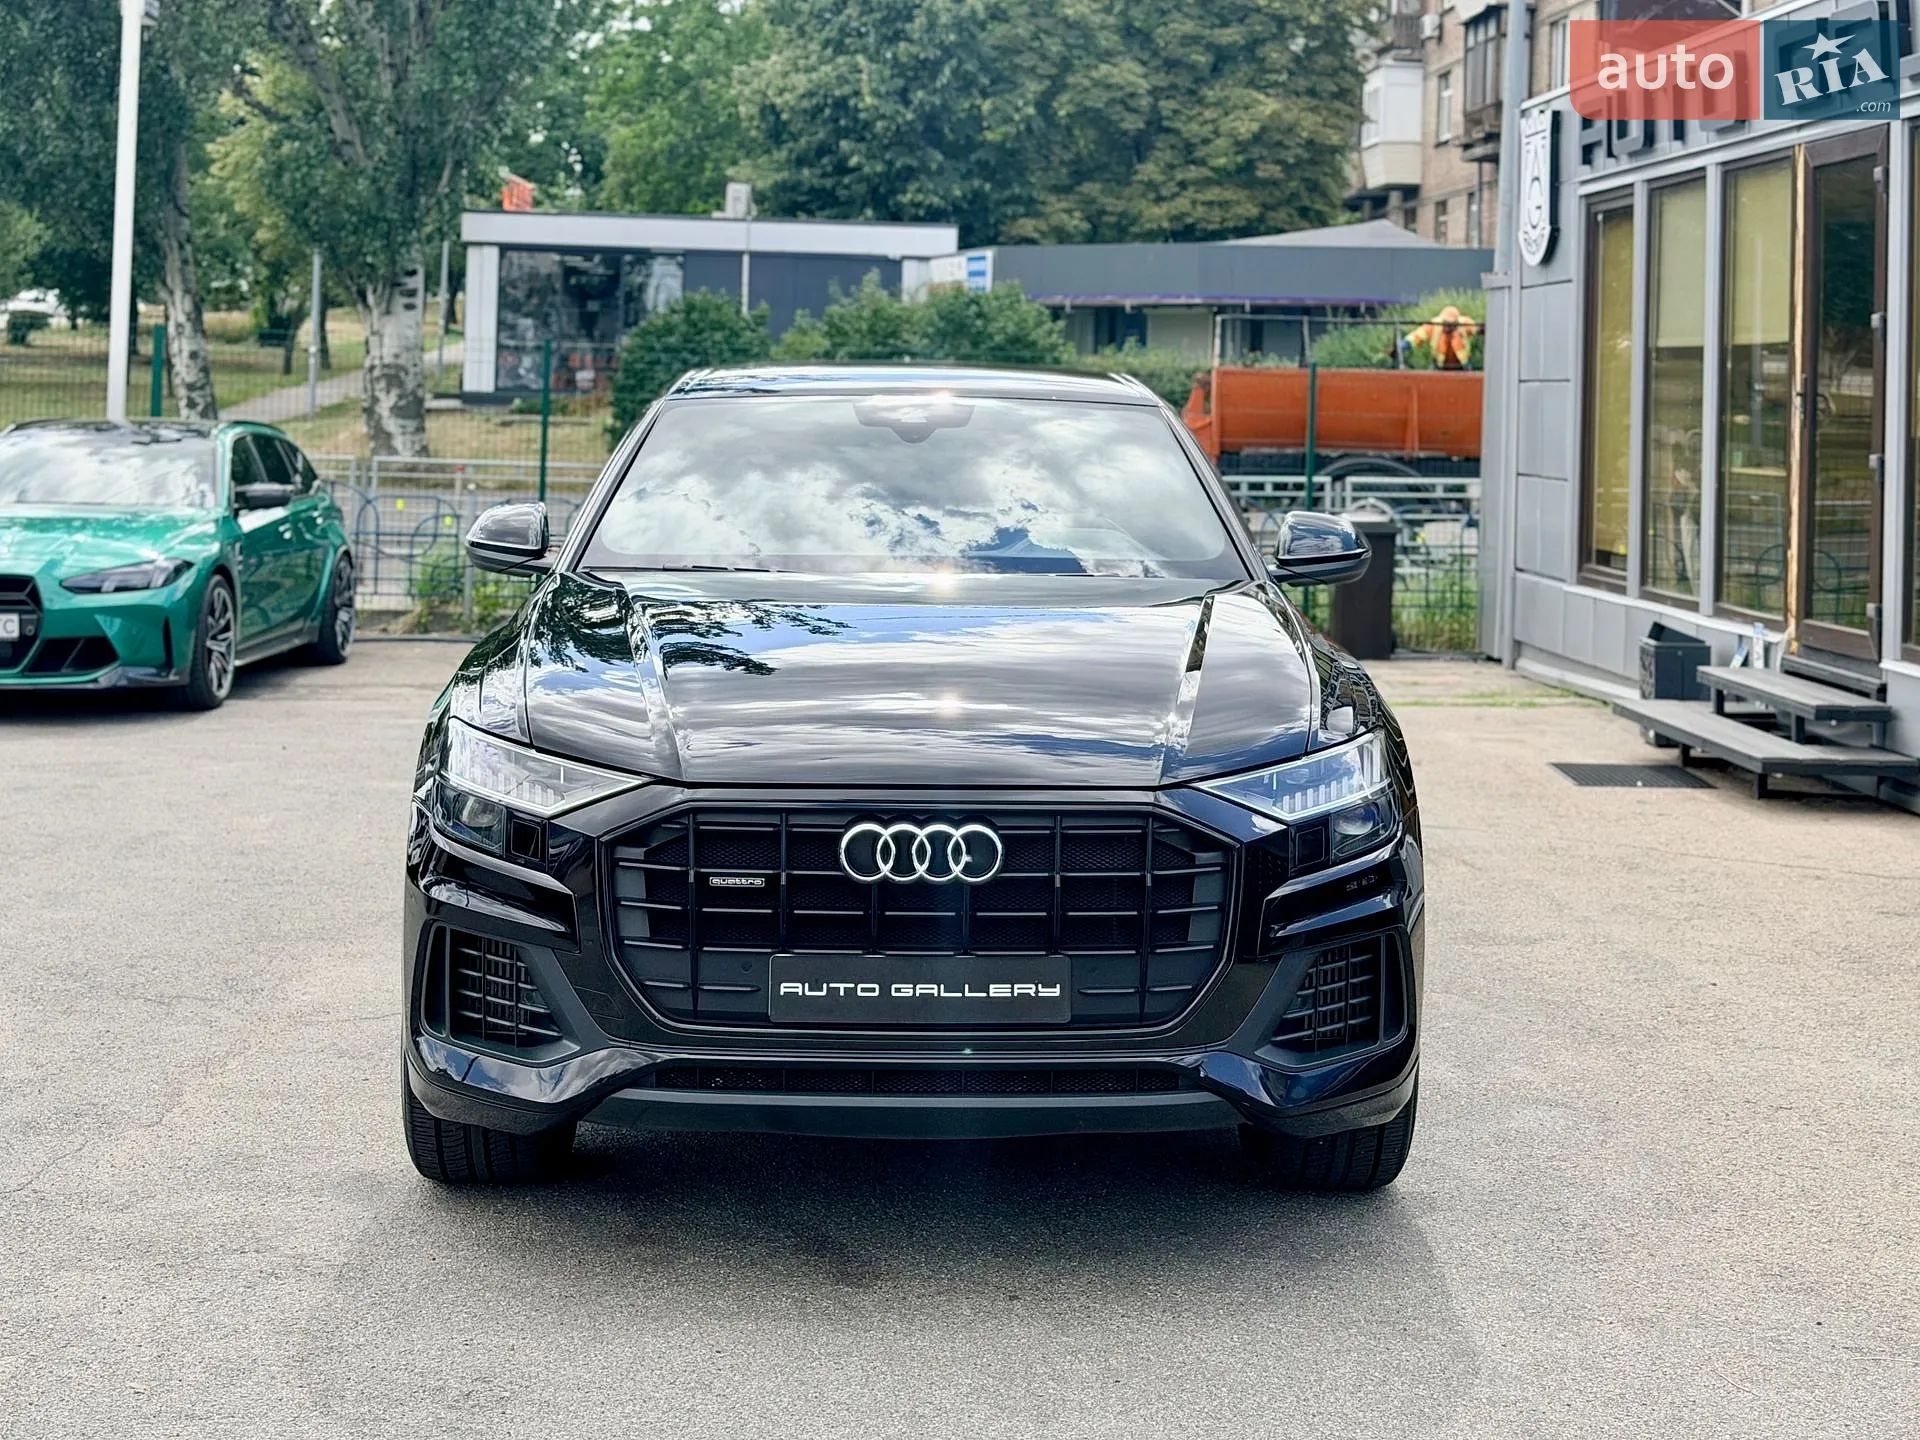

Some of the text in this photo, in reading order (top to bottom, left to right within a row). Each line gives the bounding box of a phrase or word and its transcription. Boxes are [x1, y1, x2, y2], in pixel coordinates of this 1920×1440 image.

[0, 618, 16, 635] C
[712, 877, 762, 886] quattro
[779, 982, 1061, 997] AUTO GALLERY
